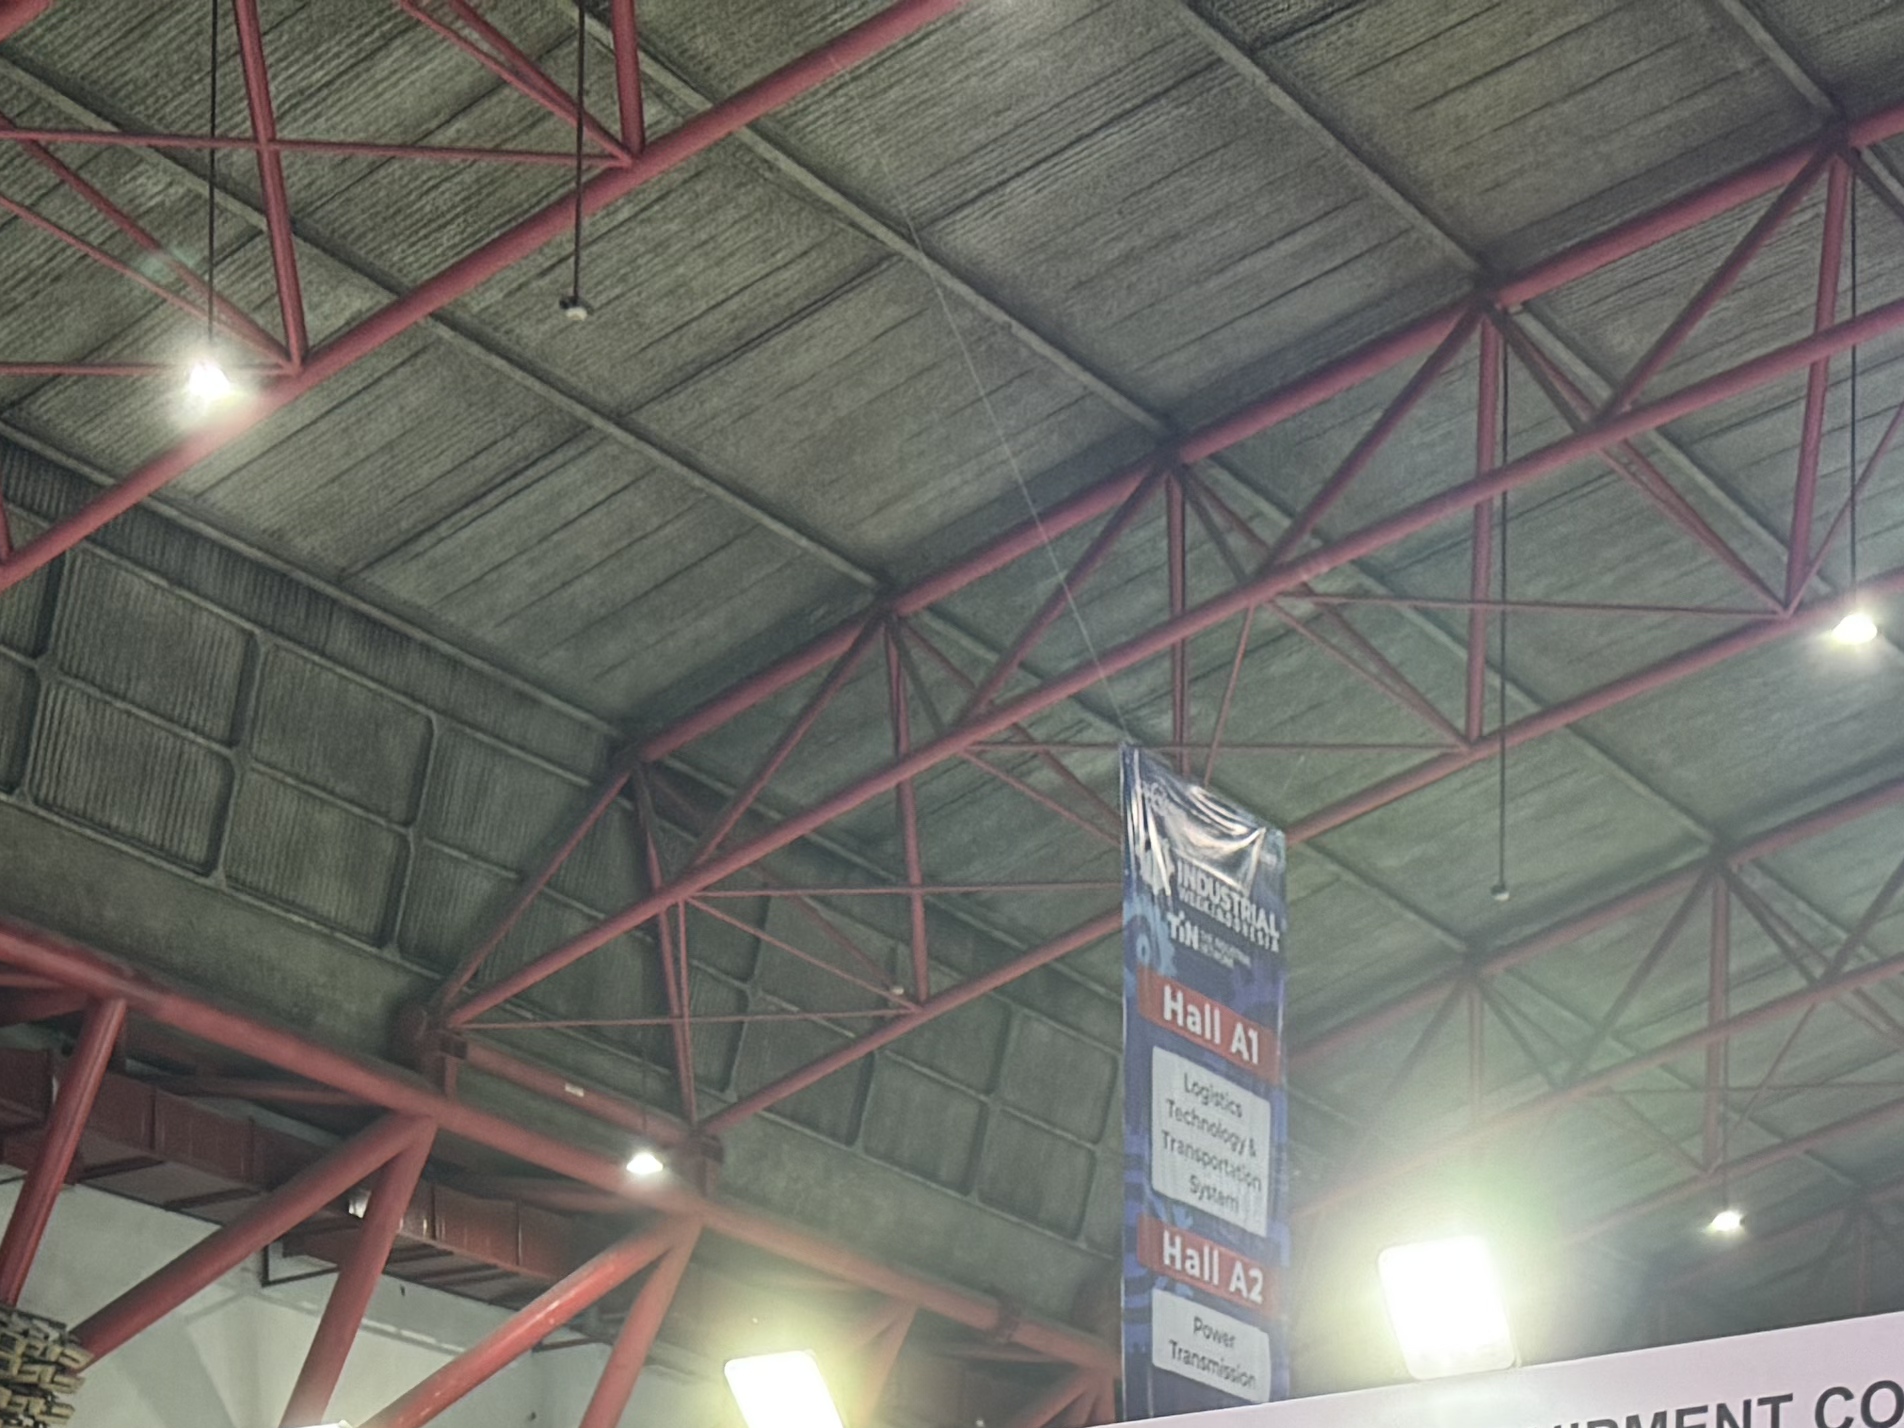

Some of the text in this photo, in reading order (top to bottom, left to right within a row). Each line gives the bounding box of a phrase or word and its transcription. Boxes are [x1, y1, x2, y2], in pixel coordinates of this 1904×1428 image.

[1177, 860, 1281, 938] INDUSTRIAL
[1163, 984, 1261, 1066] Hall A1
[1183, 1072, 1243, 1118] Logistics
[1166, 1099, 1257, 1158] Technology &
[1161, 1130, 1262, 1192] Transportation
[1189, 1174, 1240, 1213] System
[1162, 1230, 1263, 1305] Hall A2
[1193, 1316, 1236, 1349] Power
[1168, 1339, 1257, 1392] Transmission
